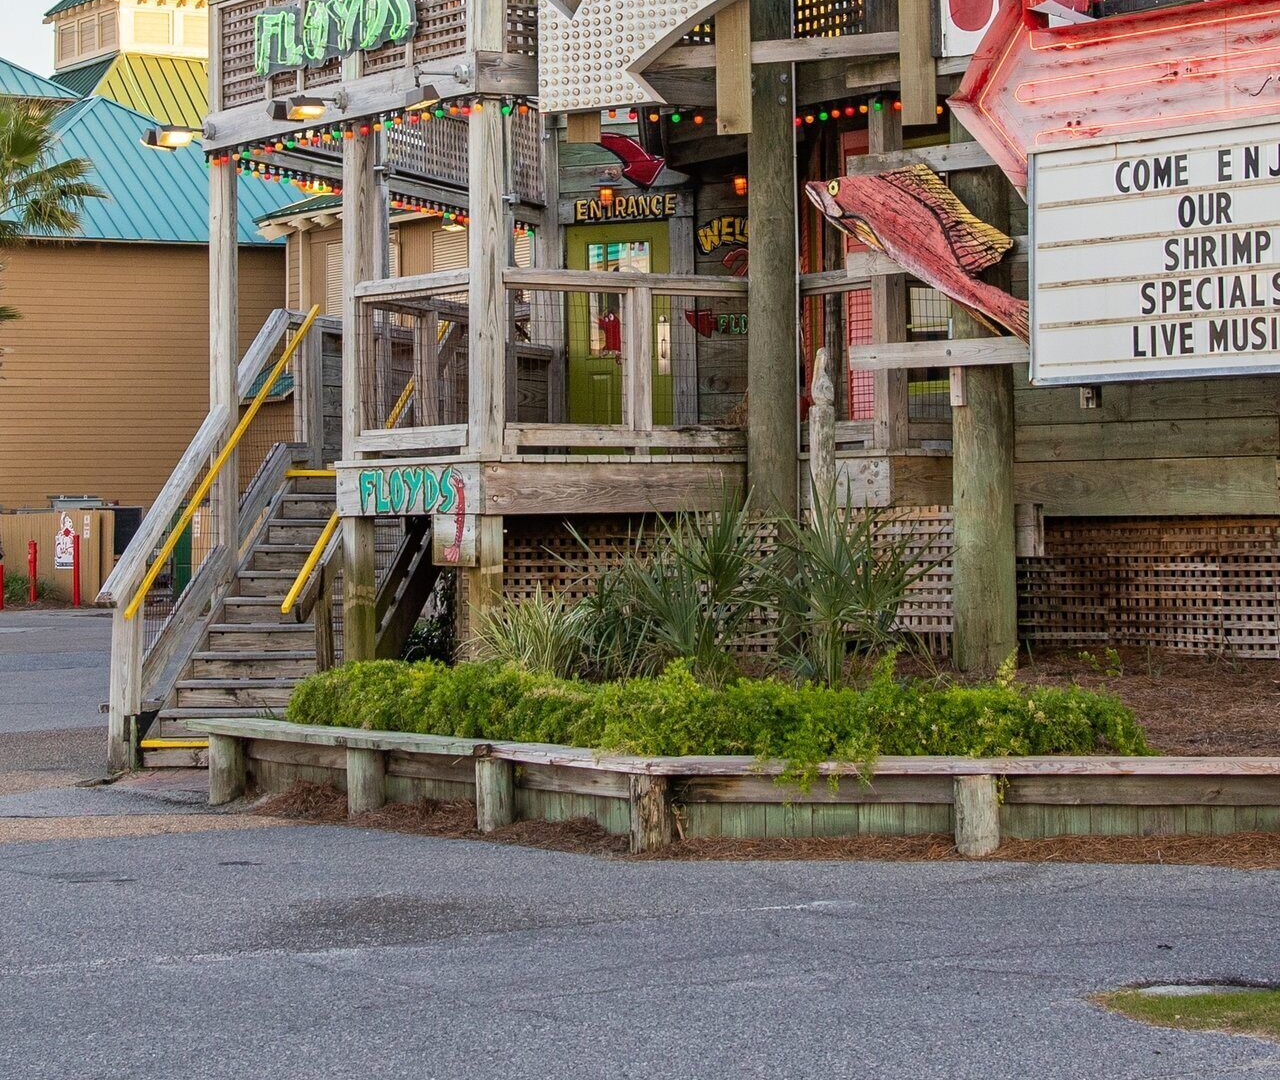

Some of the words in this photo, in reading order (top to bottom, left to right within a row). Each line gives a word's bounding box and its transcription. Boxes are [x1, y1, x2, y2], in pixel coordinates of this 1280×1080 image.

[1115, 153, 1189, 193] COME
[1178, 192, 1233, 228] OUR
[1164, 230, 1272, 271] SHRIMP
[1132, 321, 1195, 358] LIVE
[359, 465, 456, 516] FLOYDS
